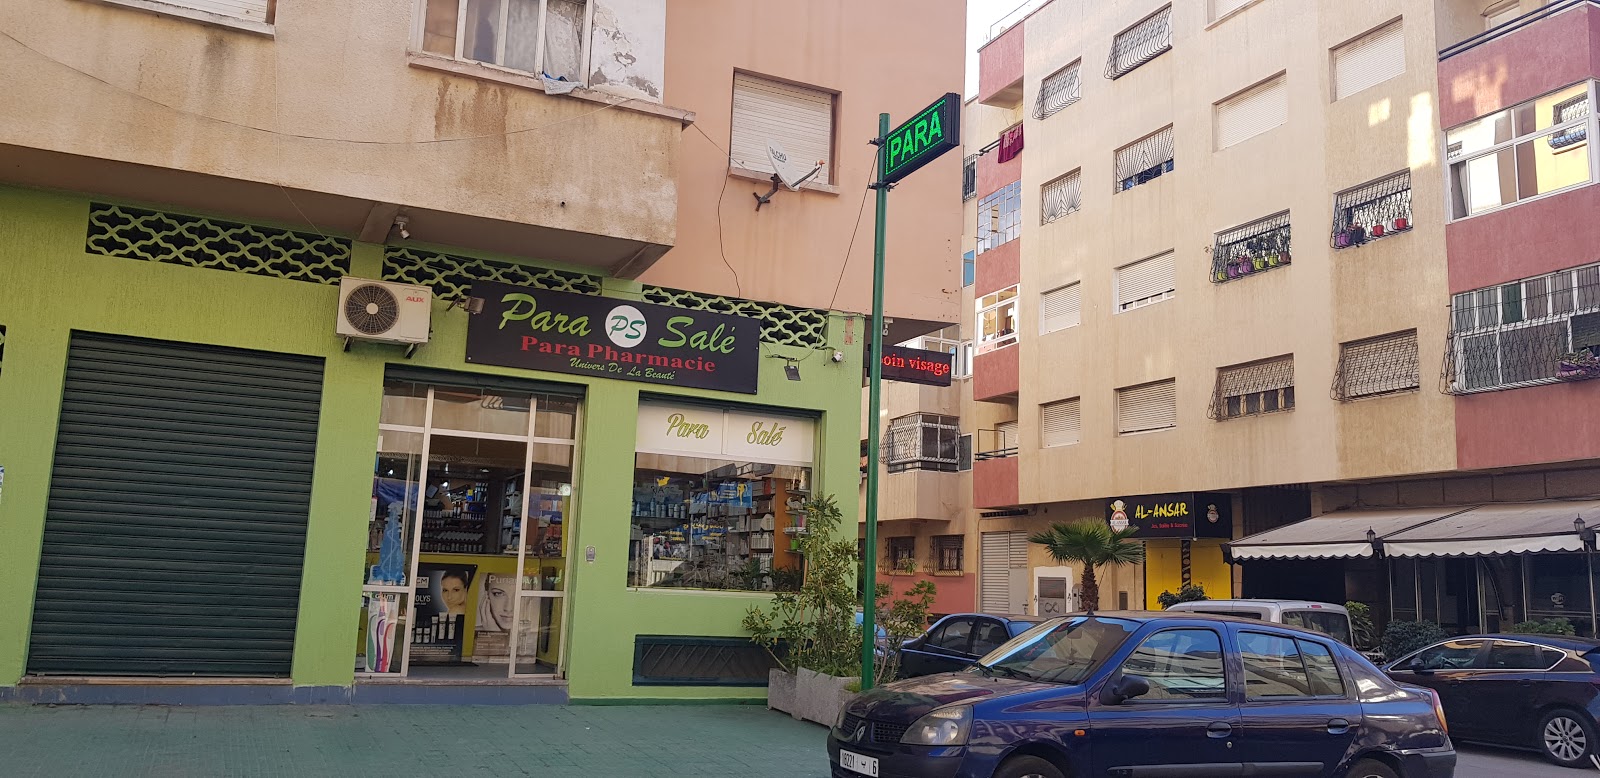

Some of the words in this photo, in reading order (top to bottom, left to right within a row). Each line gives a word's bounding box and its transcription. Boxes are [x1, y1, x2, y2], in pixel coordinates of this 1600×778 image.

[889, 110, 943, 168] PARA
[498, 292, 592, 337] Para
[610, 315, 646, 340] PS
[658, 315, 736, 354] Salé
[520, 335, 581, 356] Para
[587, 342, 716, 372] Pharmacie
[881, 353, 905, 368] oin
[909, 357, 950, 376] visage
[570, 357, 605, 371] Univers
[608, 362, 622, 374] De
[626, 366, 642, 377] La
[644, 367, 676, 380] Beauté
[666, 412, 710, 439] Para
[746, 421, 786, 447] Salé
[1134, 502, 1189, 519] AL-ANSAR
[872, 760, 877, 774] 6
